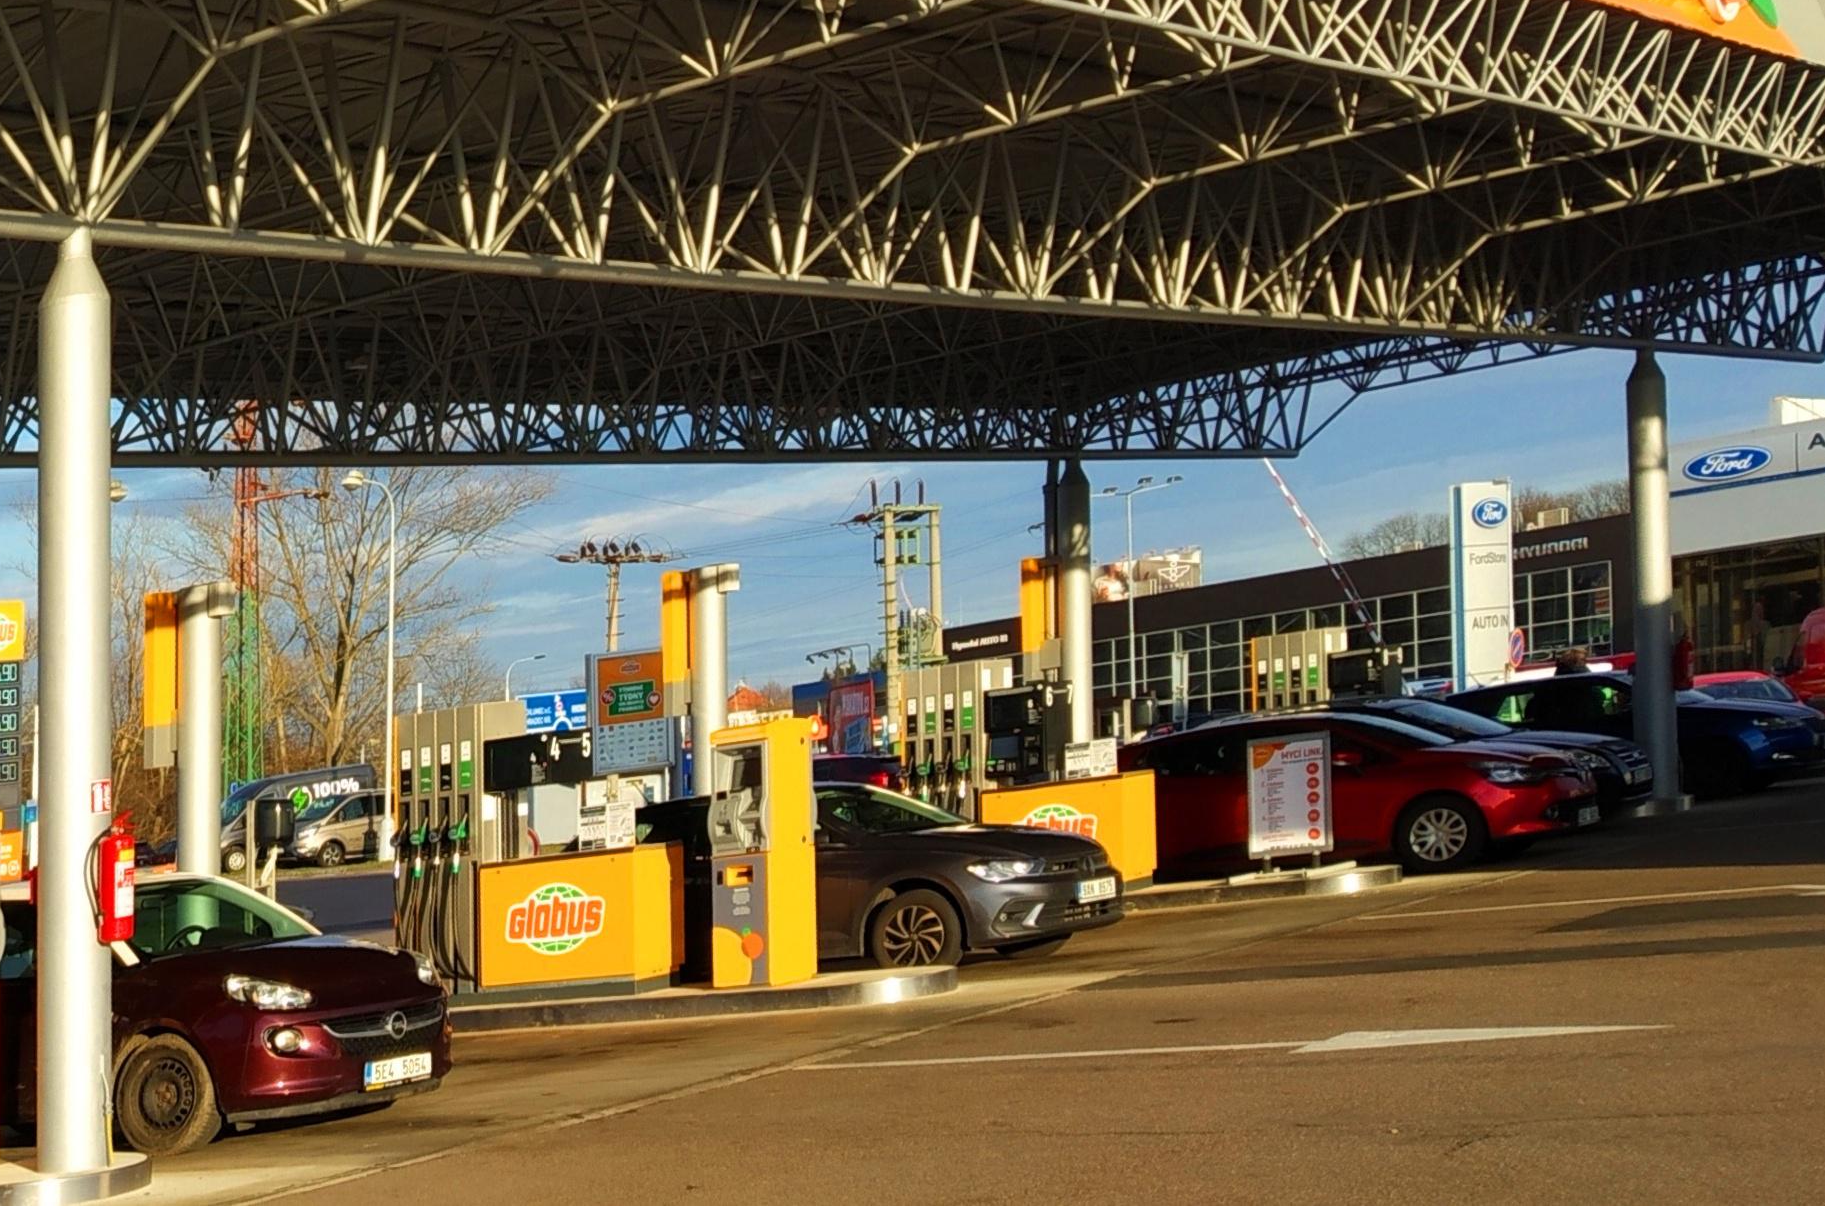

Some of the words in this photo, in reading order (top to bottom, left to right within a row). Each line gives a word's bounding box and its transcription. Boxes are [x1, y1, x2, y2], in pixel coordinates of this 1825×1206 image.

[1700, 451, 1754, 475] Ford
[1481, 502, 1504, 521] Ford
[1468, 552, 1507, 566] FordStore
[1513, 536, 1589, 560] HYUNDAI
[1472, 614, 1499, 630] AUTO
[1045, 685, 1054, 707] 6
[1066, 684, 1073, 705] 7
[550, 736, 561, 761] 4
[582, 732, 591, 758] 5
[312, 777, 360, 798] 100%
[508, 894, 603, 940] Globus
[375, 1062, 394, 1081] 5E4
